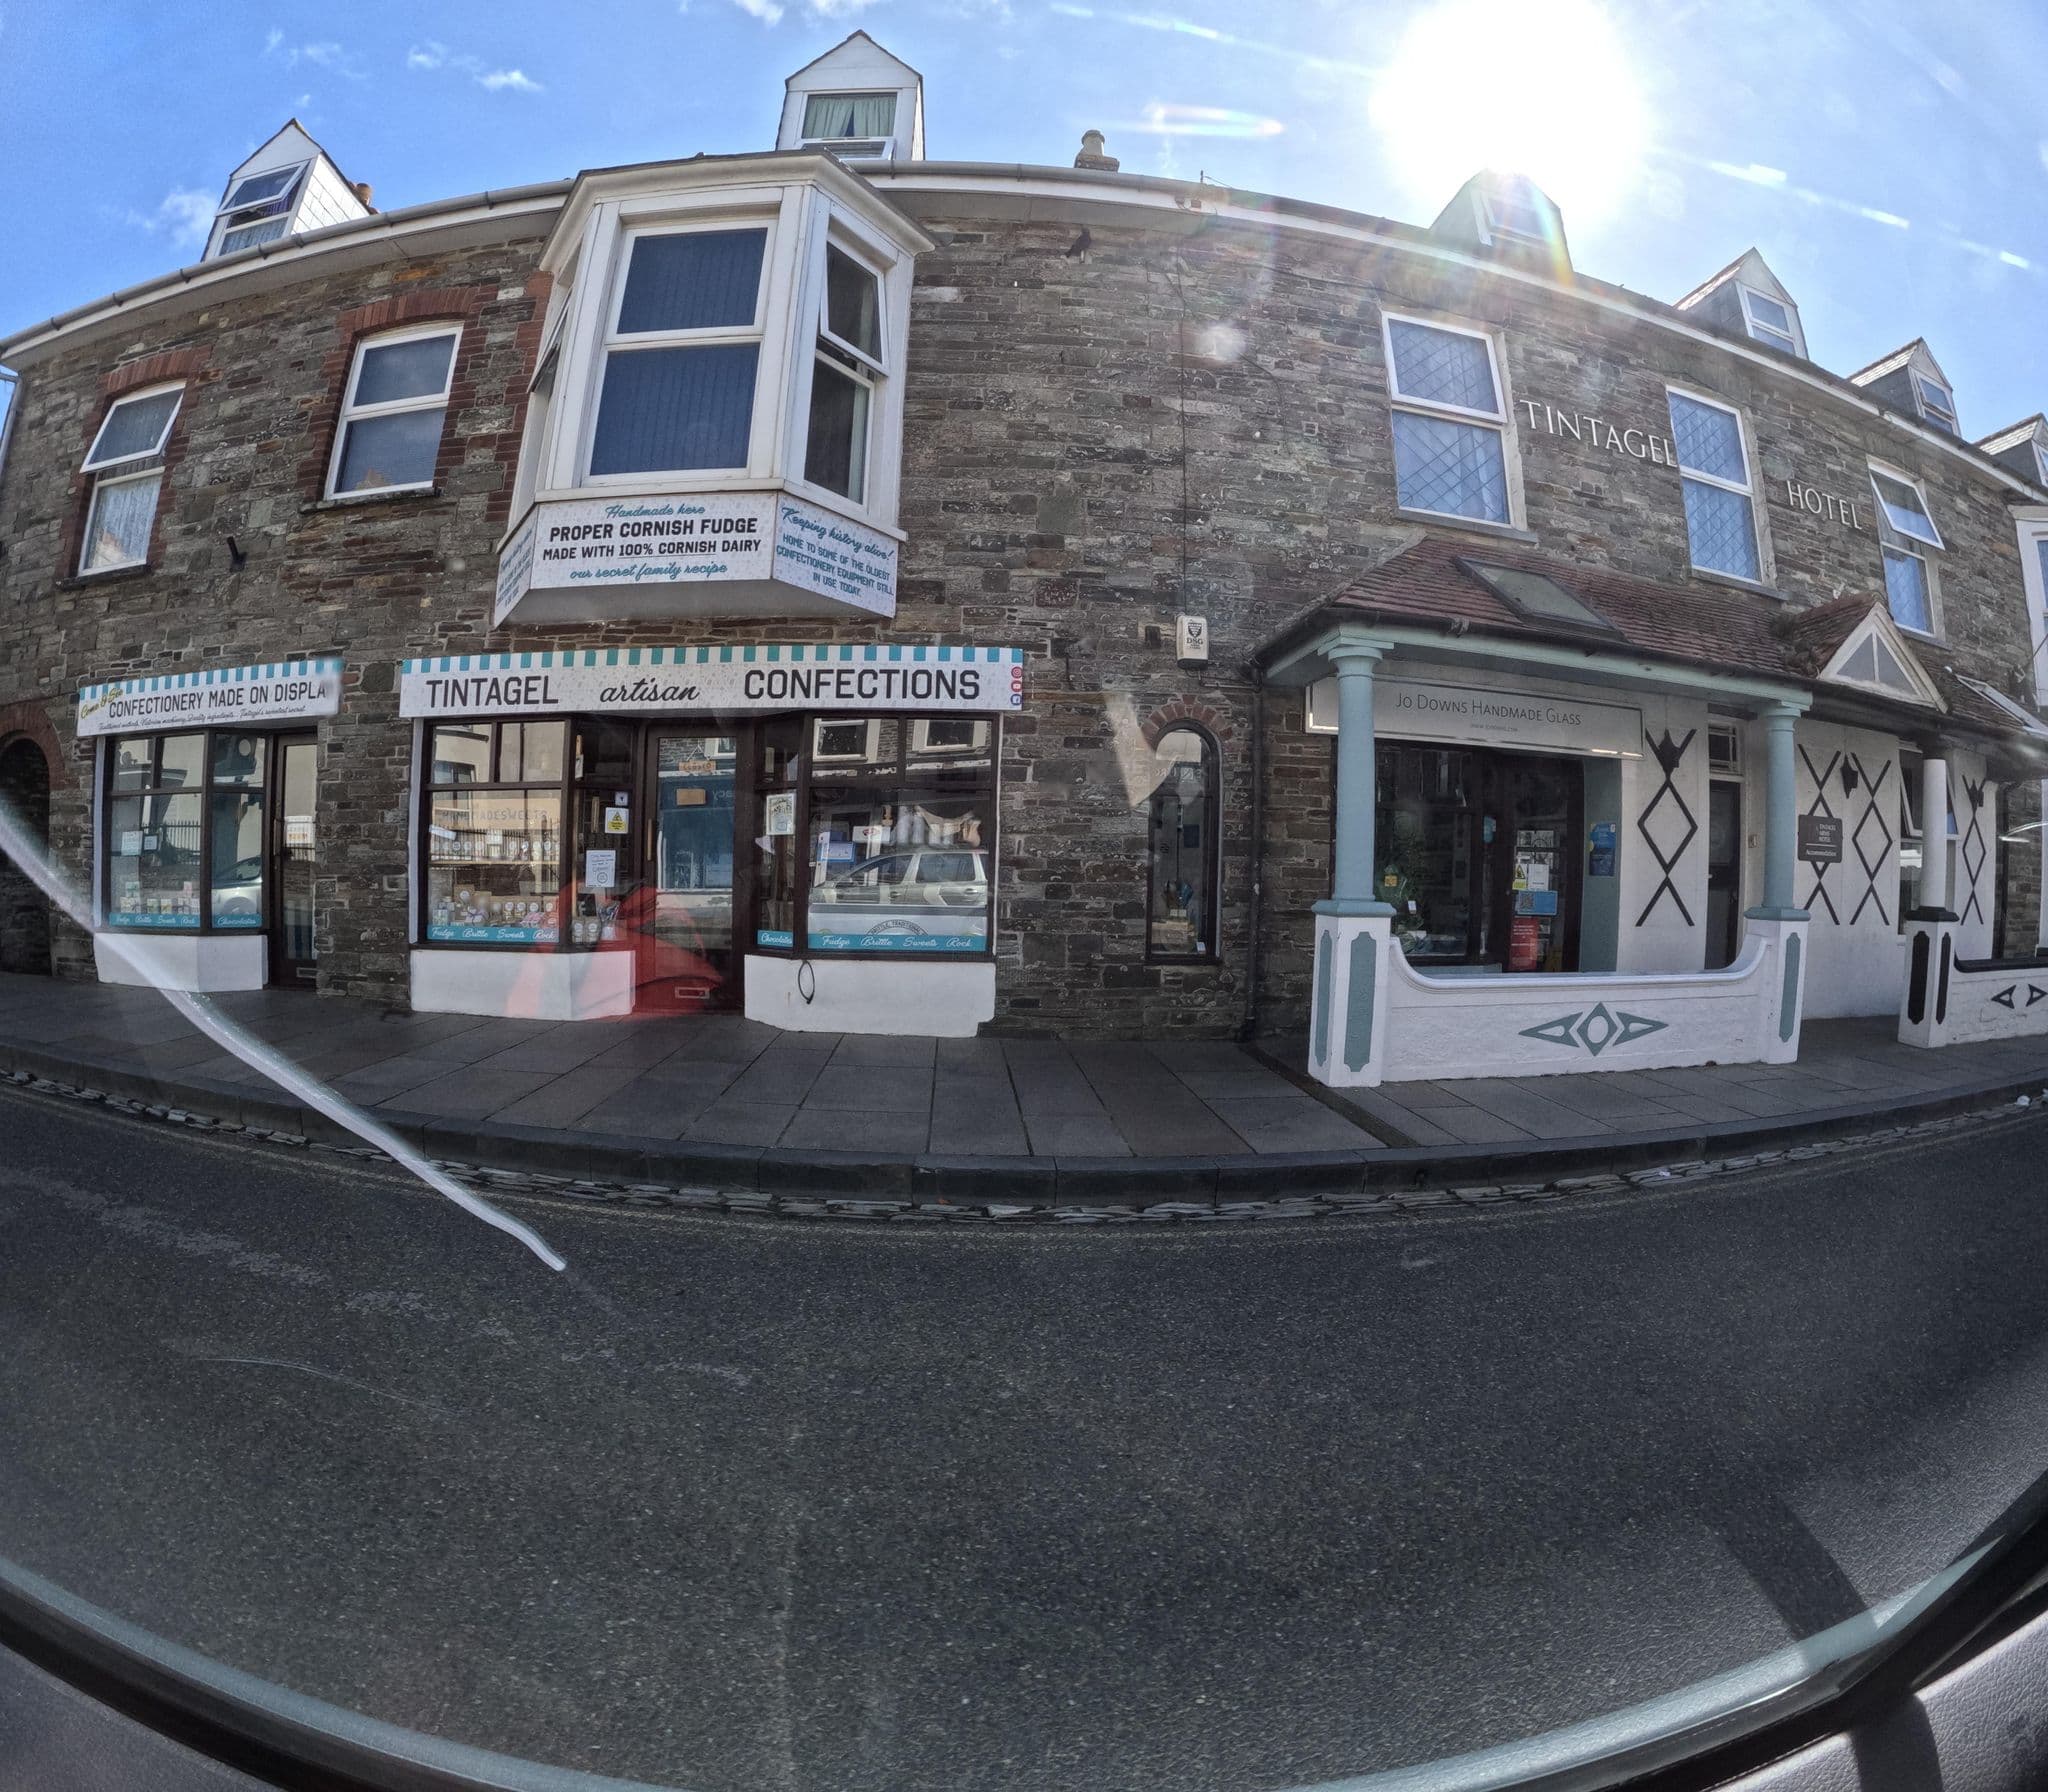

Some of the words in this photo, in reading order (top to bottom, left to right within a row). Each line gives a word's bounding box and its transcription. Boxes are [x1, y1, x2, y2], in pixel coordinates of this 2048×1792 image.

[1520, 399, 1678, 468] TINTAGEL
[605, 504, 673, 519] Handmade
[677, 503, 705, 514] here
[1787, 480, 1862, 529] HOTEL
[550, 524, 613, 542] PROPER
[620, 520, 694, 538] CORNISH
[701, 518, 757, 534] FUDGE
[782, 507, 827, 539] Keeping
[829, 527, 862, 553] history
[864, 544, 894, 560] alive!
[543, 547, 577, 560] MADE
[582, 545, 614, 558] WITH
[619, 543, 653, 557] 100%
[658, 541, 716, 554] CORNISH
[722, 539, 761, 552] DAIRY
[783, 533, 804, 549] HOME
[806, 542, 816, 553] TO
[818, 547, 837, 561] SOME
[840, 554, 849, 565] OF
[852, 559, 864, 571] THE
[866, 563, 890, 581] OLDEST
[570, 569, 593, 579] our
[595, 565, 637, 577] secret
[635, 562, 681, 581] family
[684, 561, 728, 578] recipe
[777, 545, 835, 573] CONFECTIONERY
[837, 567, 875, 588] EQUIPMENT
[876, 582, 894, 596] STILL
[813, 573, 822, 582] IN
[823, 576, 837, 588] USE
[109, 692, 203, 718] CONFECTIONERY
[209, 688, 244, 708] MADE
[250, 685, 268, 704] ON
[275, 681, 333, 702] DISPLA
[426, 675, 558, 708] TINTAGEL
[600, 677, 700, 702] artisan
[744, 669, 980, 701] CONFECTIONS
[432, 927, 455, 939] Fudge
[462, 928, 488, 938] Brittle
[497, 928, 525, 939] Sweets
[533, 930, 555, 939] Rock
[761, 933, 792, 944] Chocolates
[823, 936, 850, 948] Fudge
[861, 936, 893, 946] Brittle
[903, 937, 938, 947] Sweets
[946, 937, 972, 947] Rock
